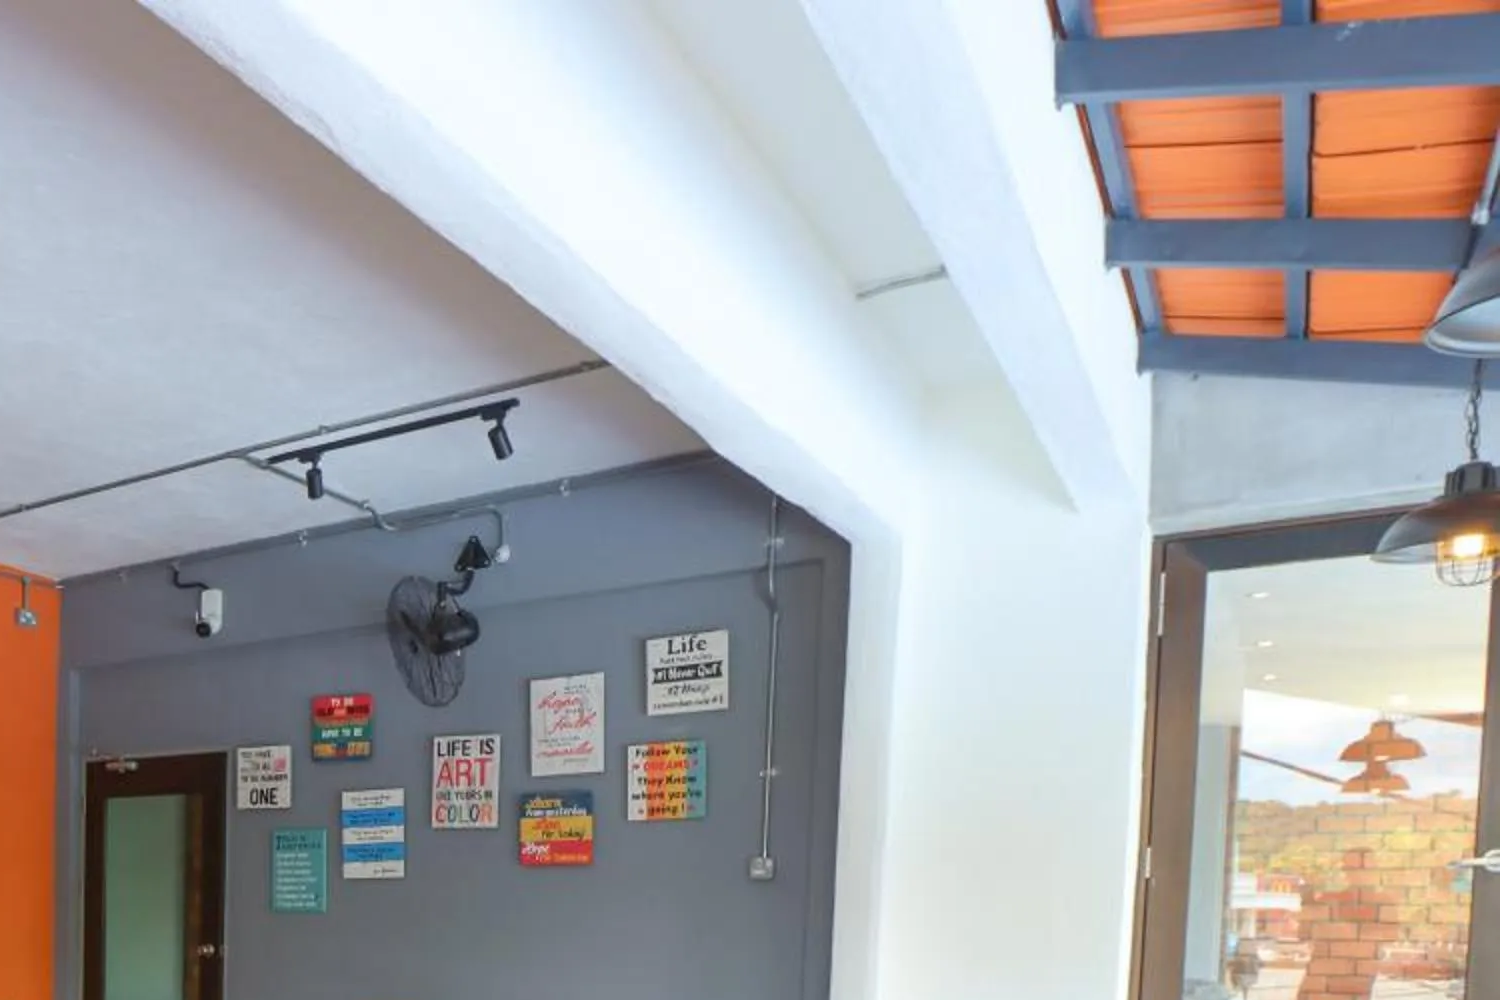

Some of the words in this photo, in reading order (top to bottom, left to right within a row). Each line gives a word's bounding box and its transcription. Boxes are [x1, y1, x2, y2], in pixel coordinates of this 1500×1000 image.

[667, 635, 707, 655] Life
[437, 739, 472, 757] LIFE
[479, 738, 495, 755] IS
[436, 758, 493, 788] ART
[250, 787, 278, 806] ONE
[435, 803, 493, 823] COLOR
